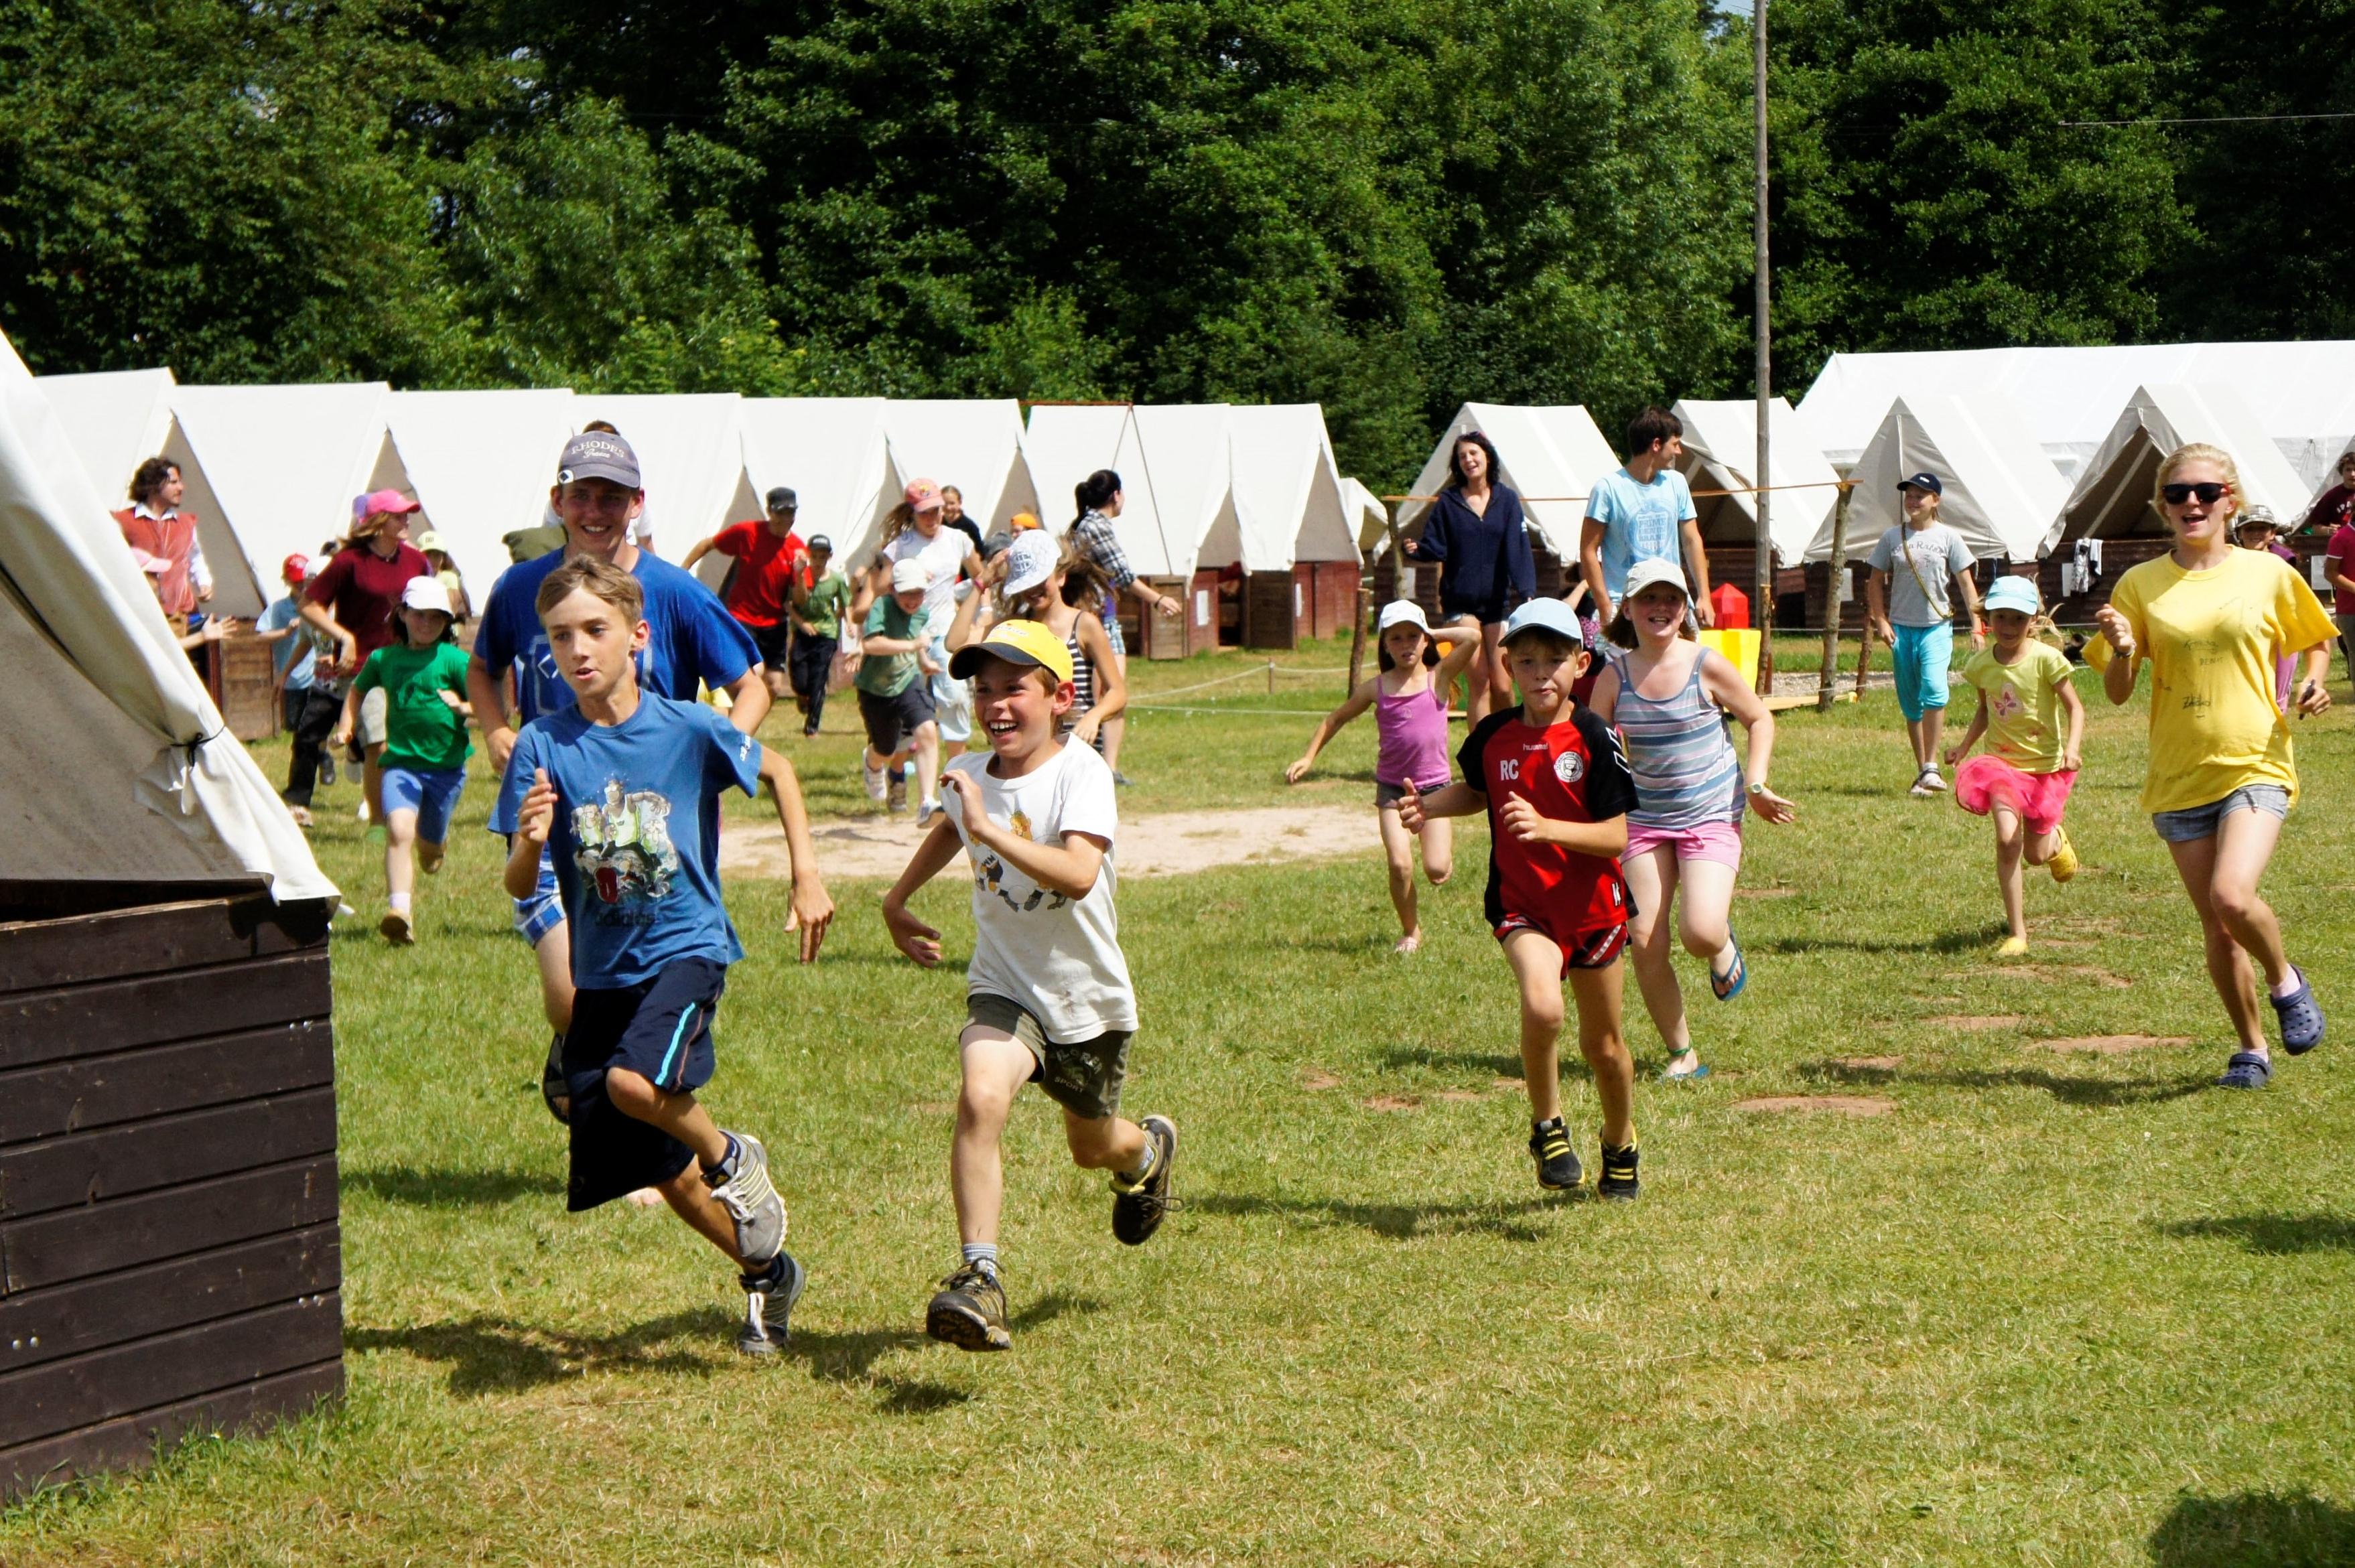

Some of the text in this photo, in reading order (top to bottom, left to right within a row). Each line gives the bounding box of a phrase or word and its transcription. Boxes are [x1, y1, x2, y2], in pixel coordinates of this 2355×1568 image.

[571, 440, 624, 458] RHODES
[1500, 759, 1519, 781] RC
[1054, 1076, 1083, 1093] SPORT
